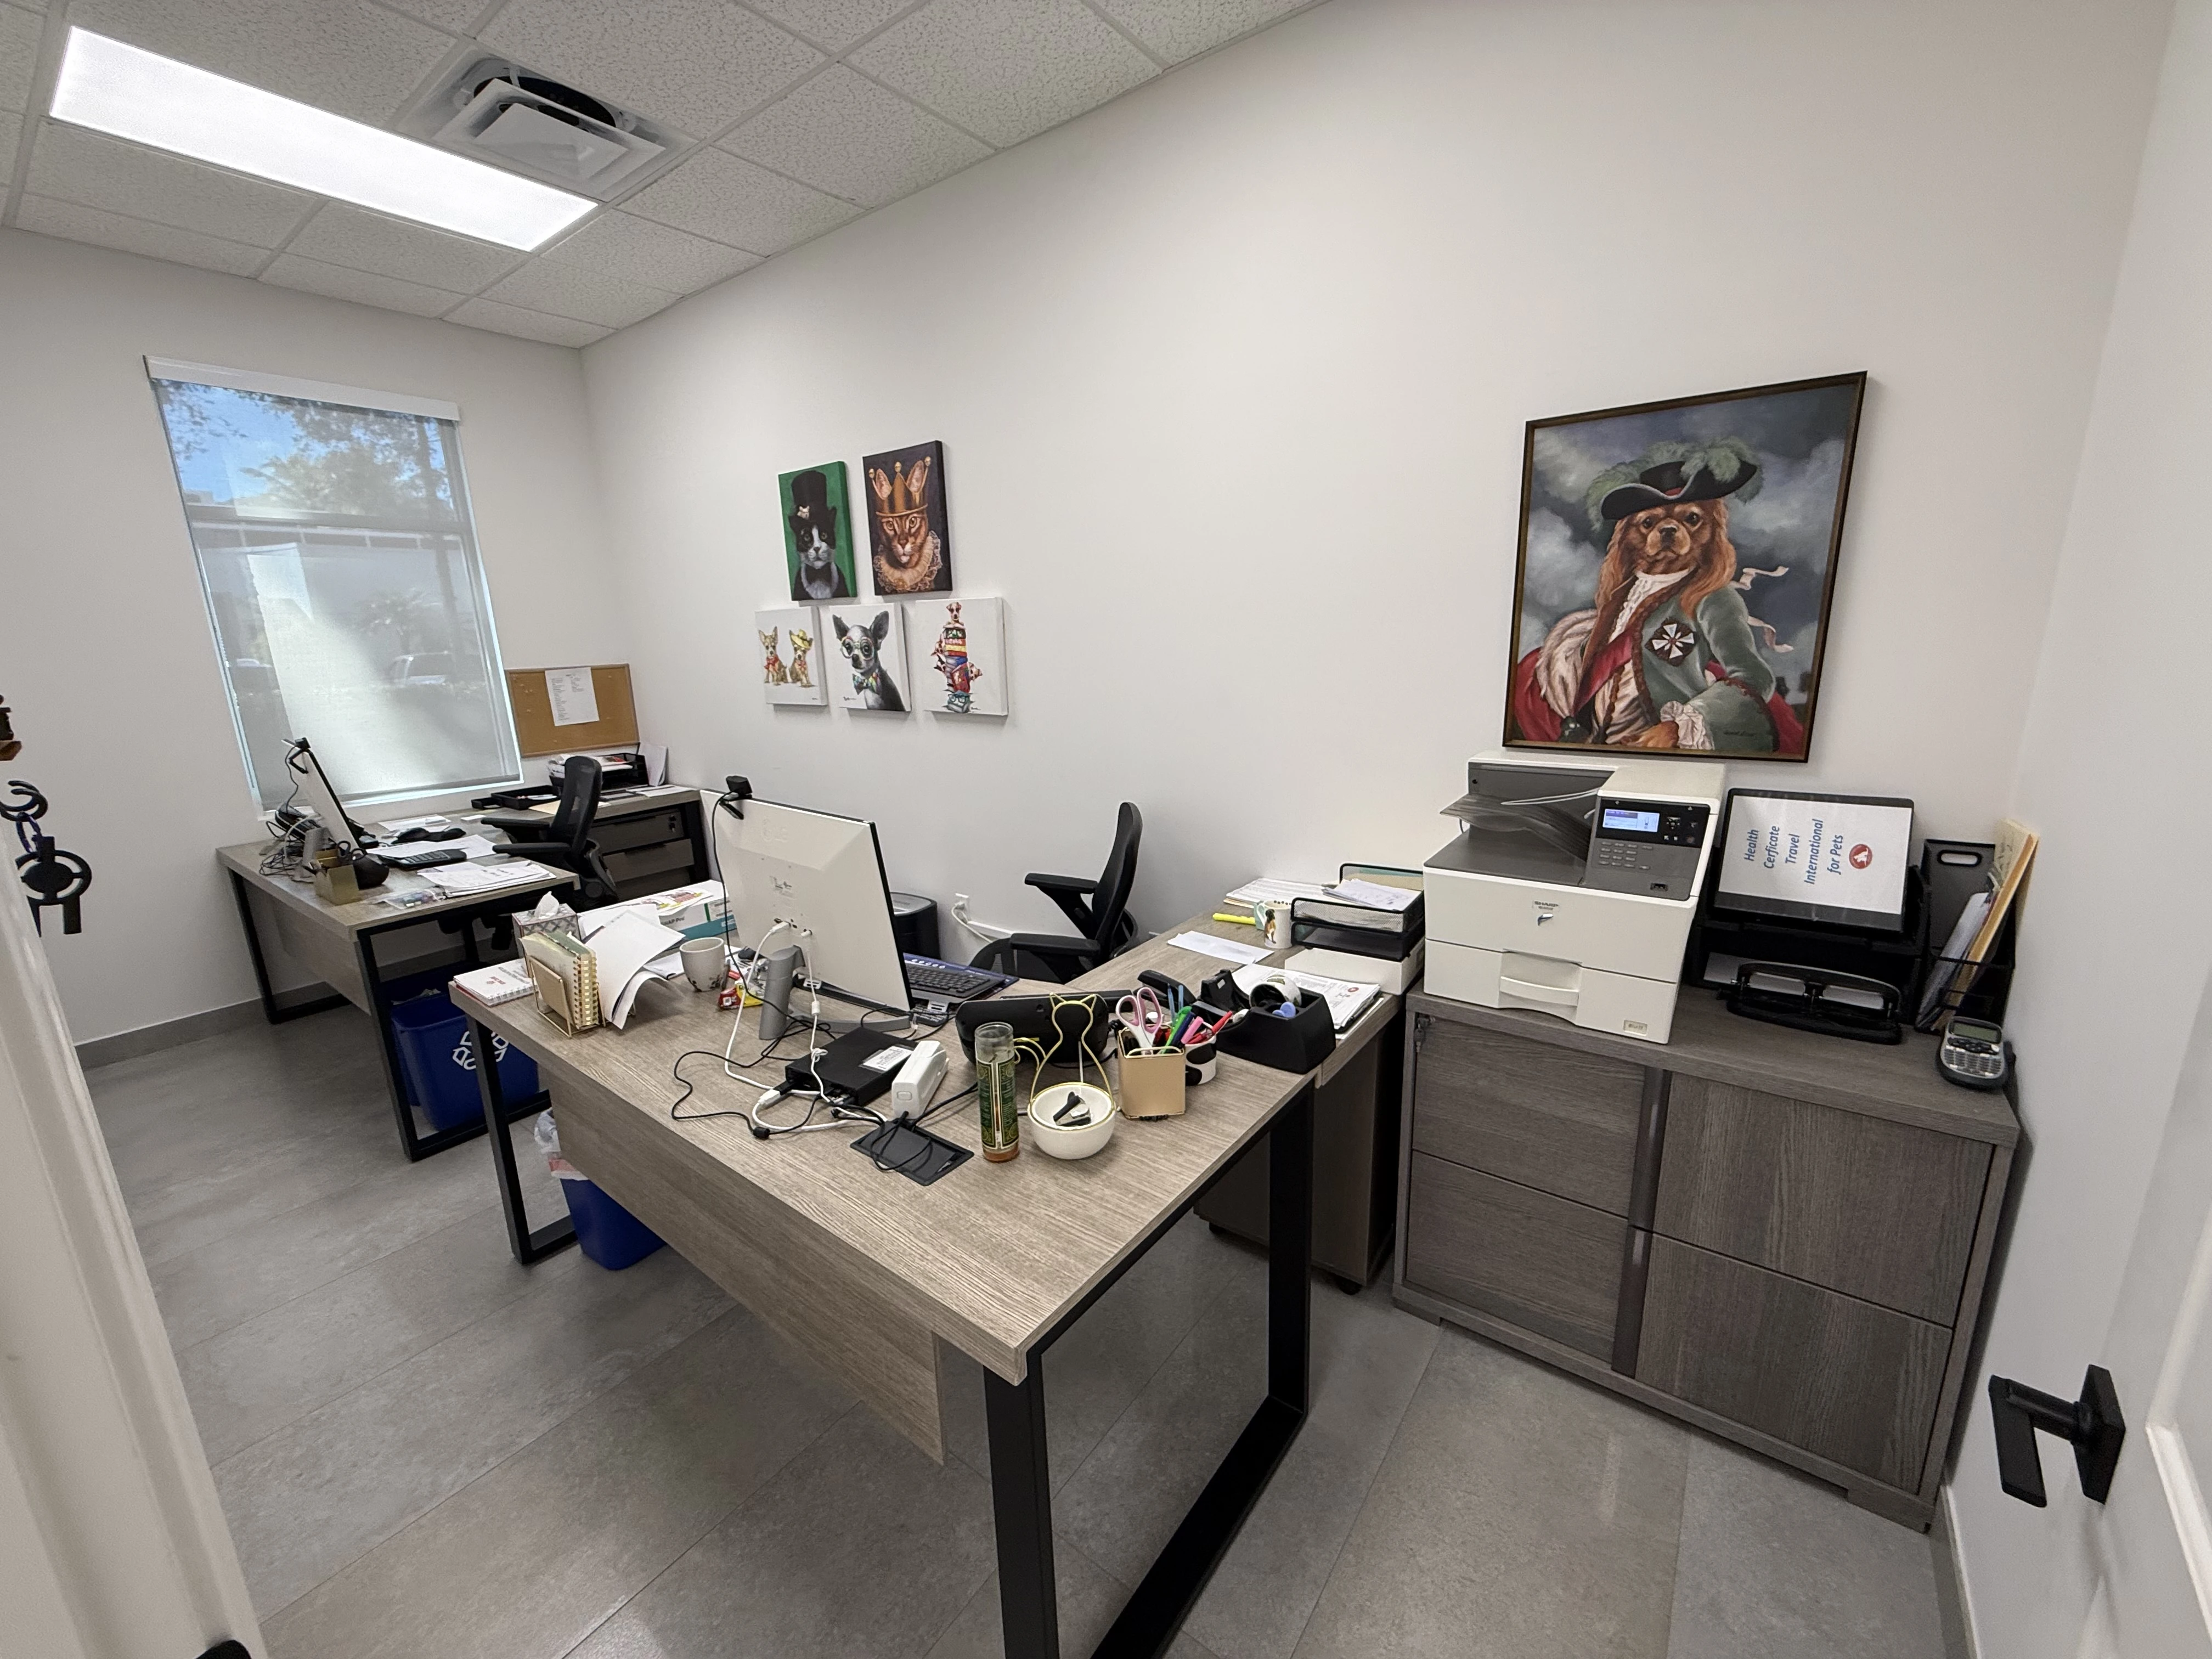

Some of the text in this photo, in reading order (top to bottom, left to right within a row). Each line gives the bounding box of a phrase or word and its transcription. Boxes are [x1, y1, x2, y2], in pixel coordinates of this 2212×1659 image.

[1743, 829, 1759, 862] Health
[1763, 826, 1780, 869] Cerficate
[1785, 833, 1800, 864] Travel
[1803, 819, 1824, 885] International
[1827, 834, 1843, 875] for Pets
